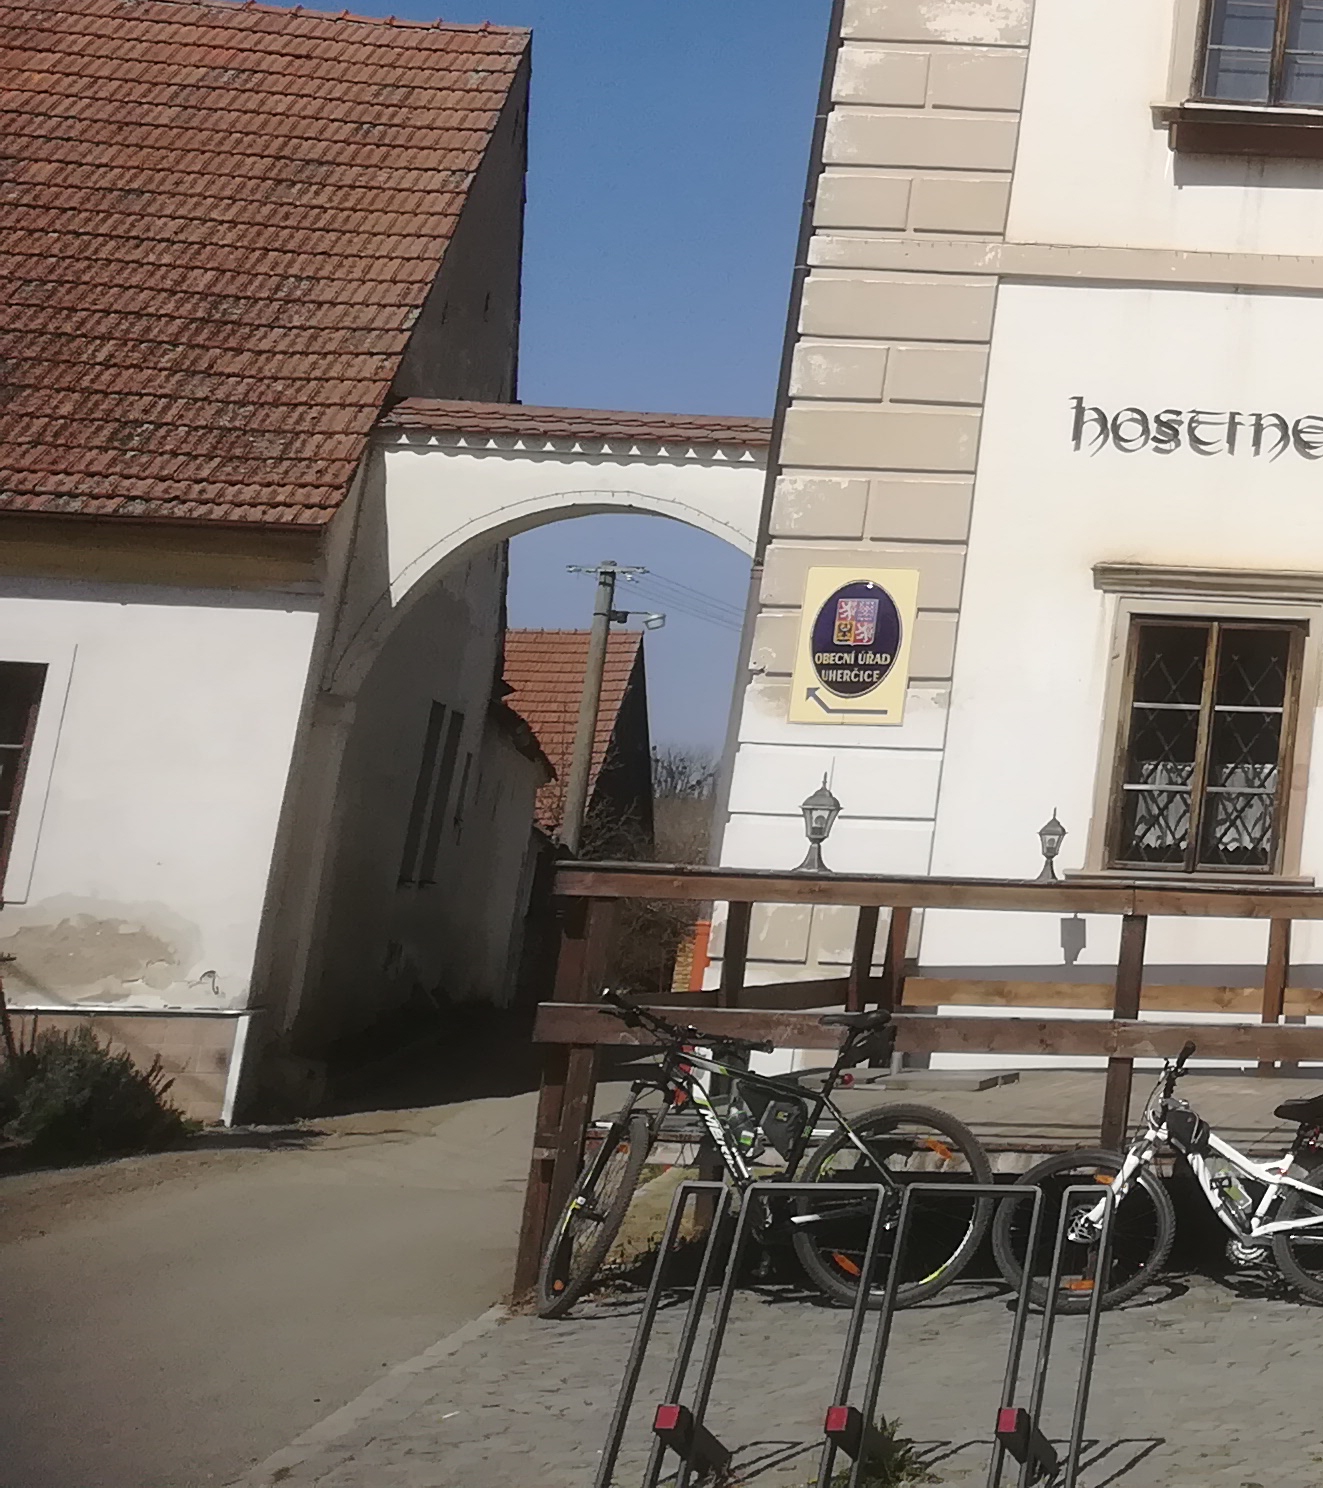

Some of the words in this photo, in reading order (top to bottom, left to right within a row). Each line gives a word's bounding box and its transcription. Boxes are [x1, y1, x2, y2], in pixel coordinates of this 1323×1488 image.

[814, 650, 855, 664] OBECNÍ
[858, 650, 891, 664] ÚŘAD
[821, 668, 880, 682] UHERČICE
